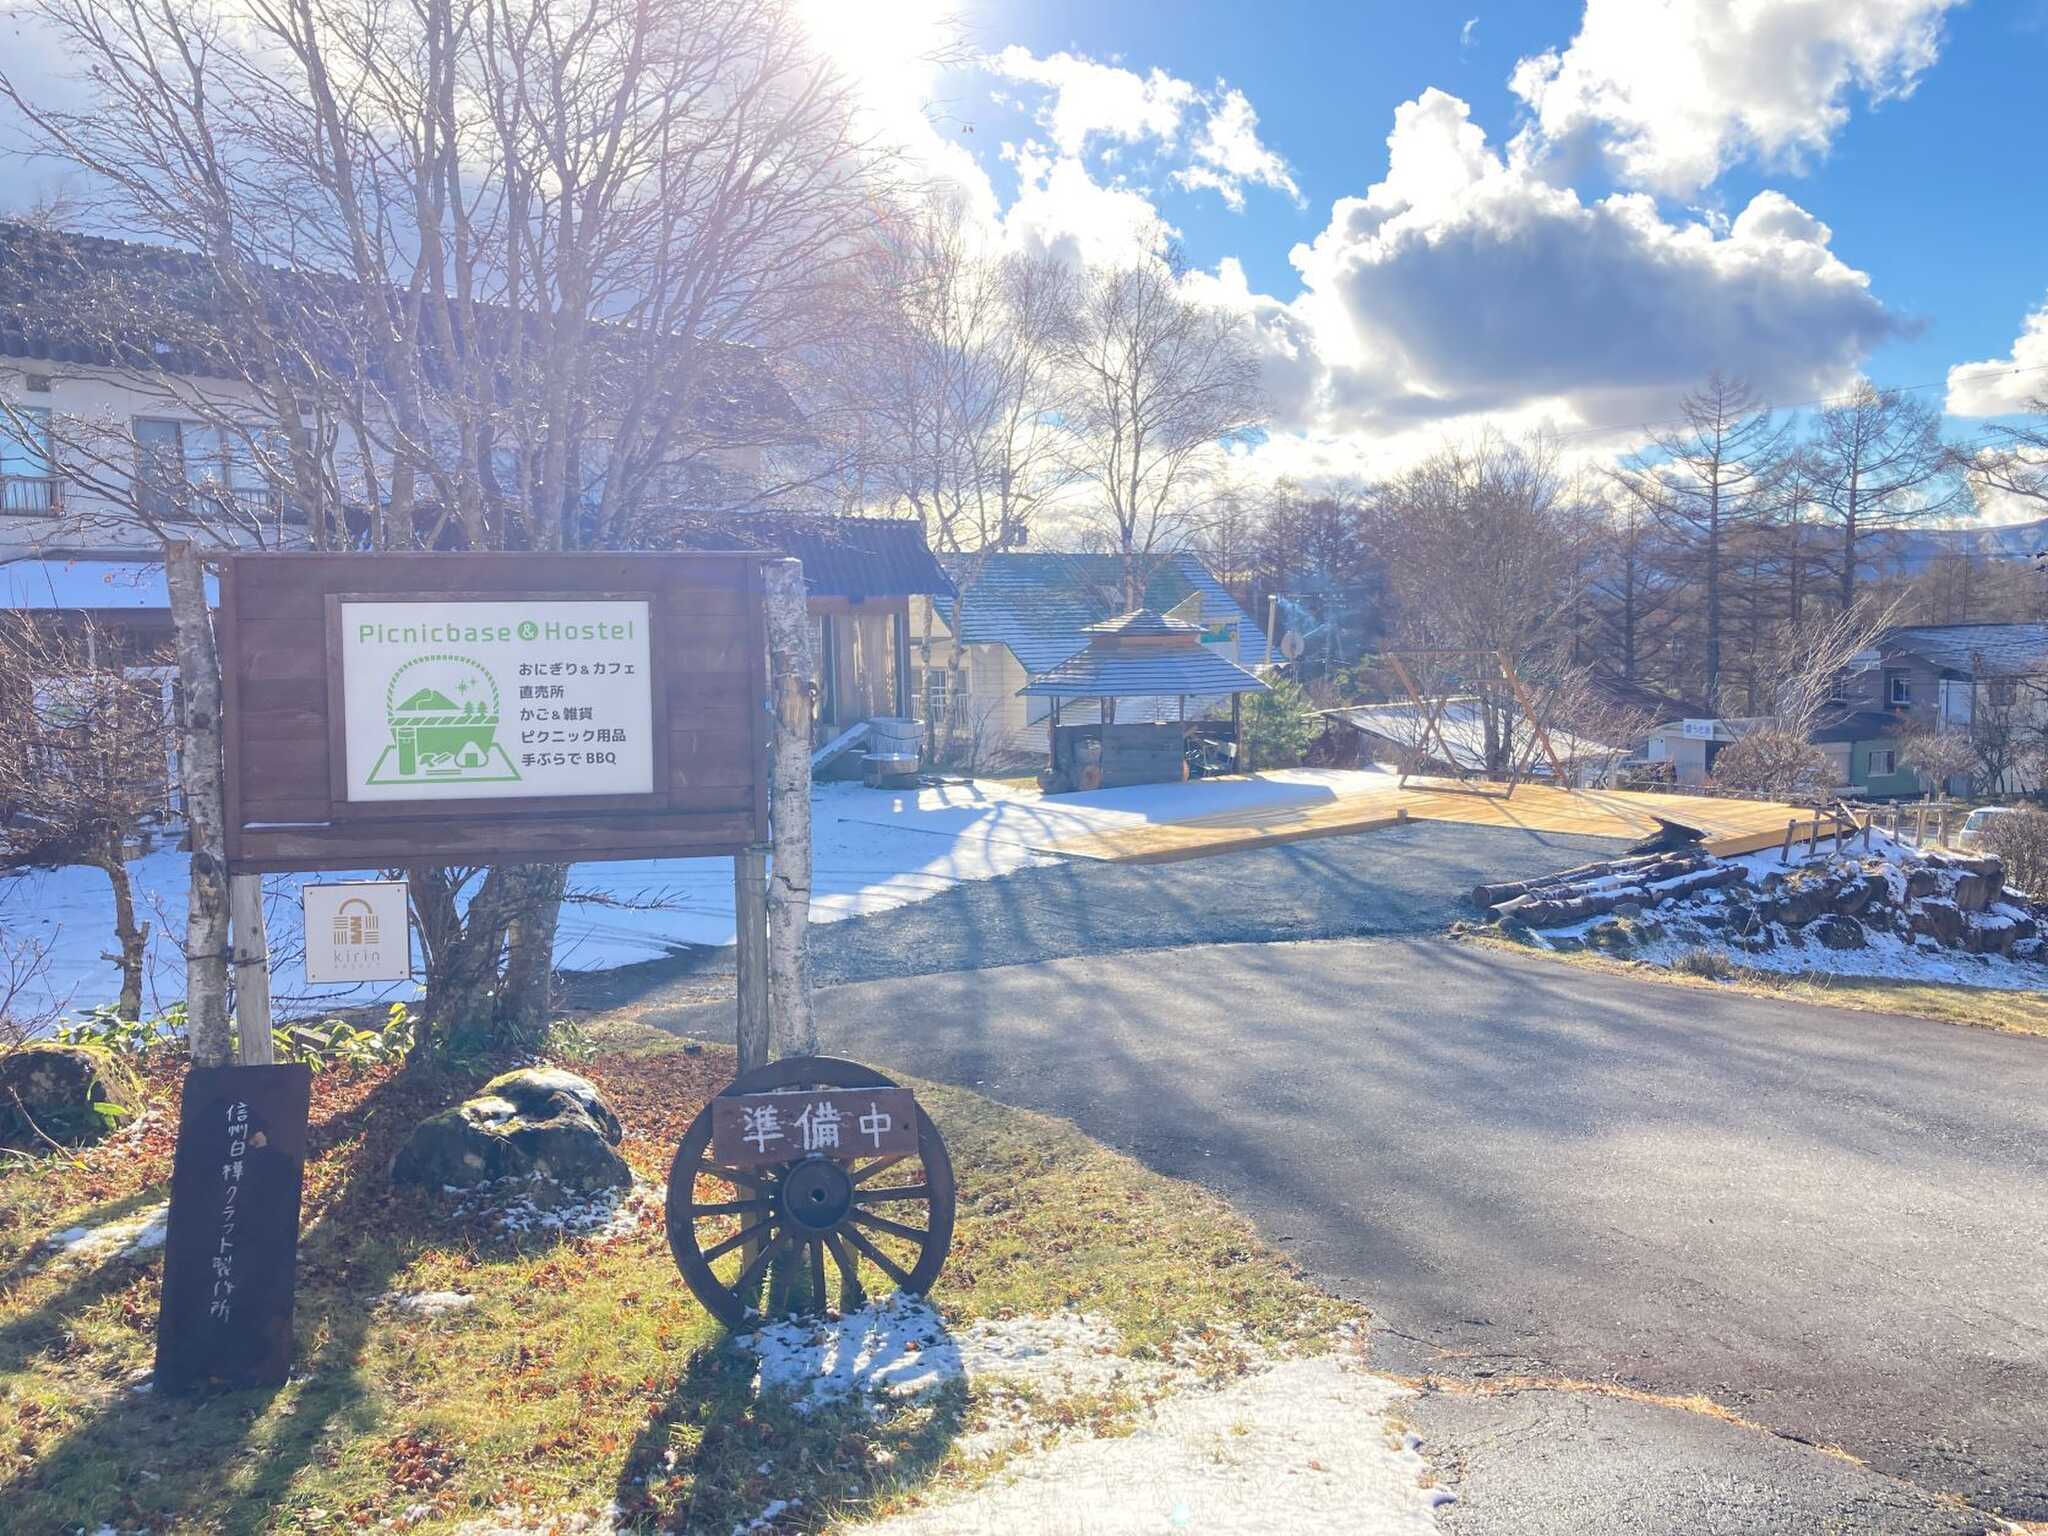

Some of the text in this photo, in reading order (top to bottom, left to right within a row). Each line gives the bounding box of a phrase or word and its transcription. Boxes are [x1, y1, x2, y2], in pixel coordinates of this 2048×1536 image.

[359, 622, 511, 643] Picnicbase
[545, 620, 633, 641] Hostel
[519, 684, 565, 699] 直売所
[521, 728, 626, 744] ピクニック用品
[334, 950, 380, 962] kirin
[740, 1100, 893, 1153] 準備中
